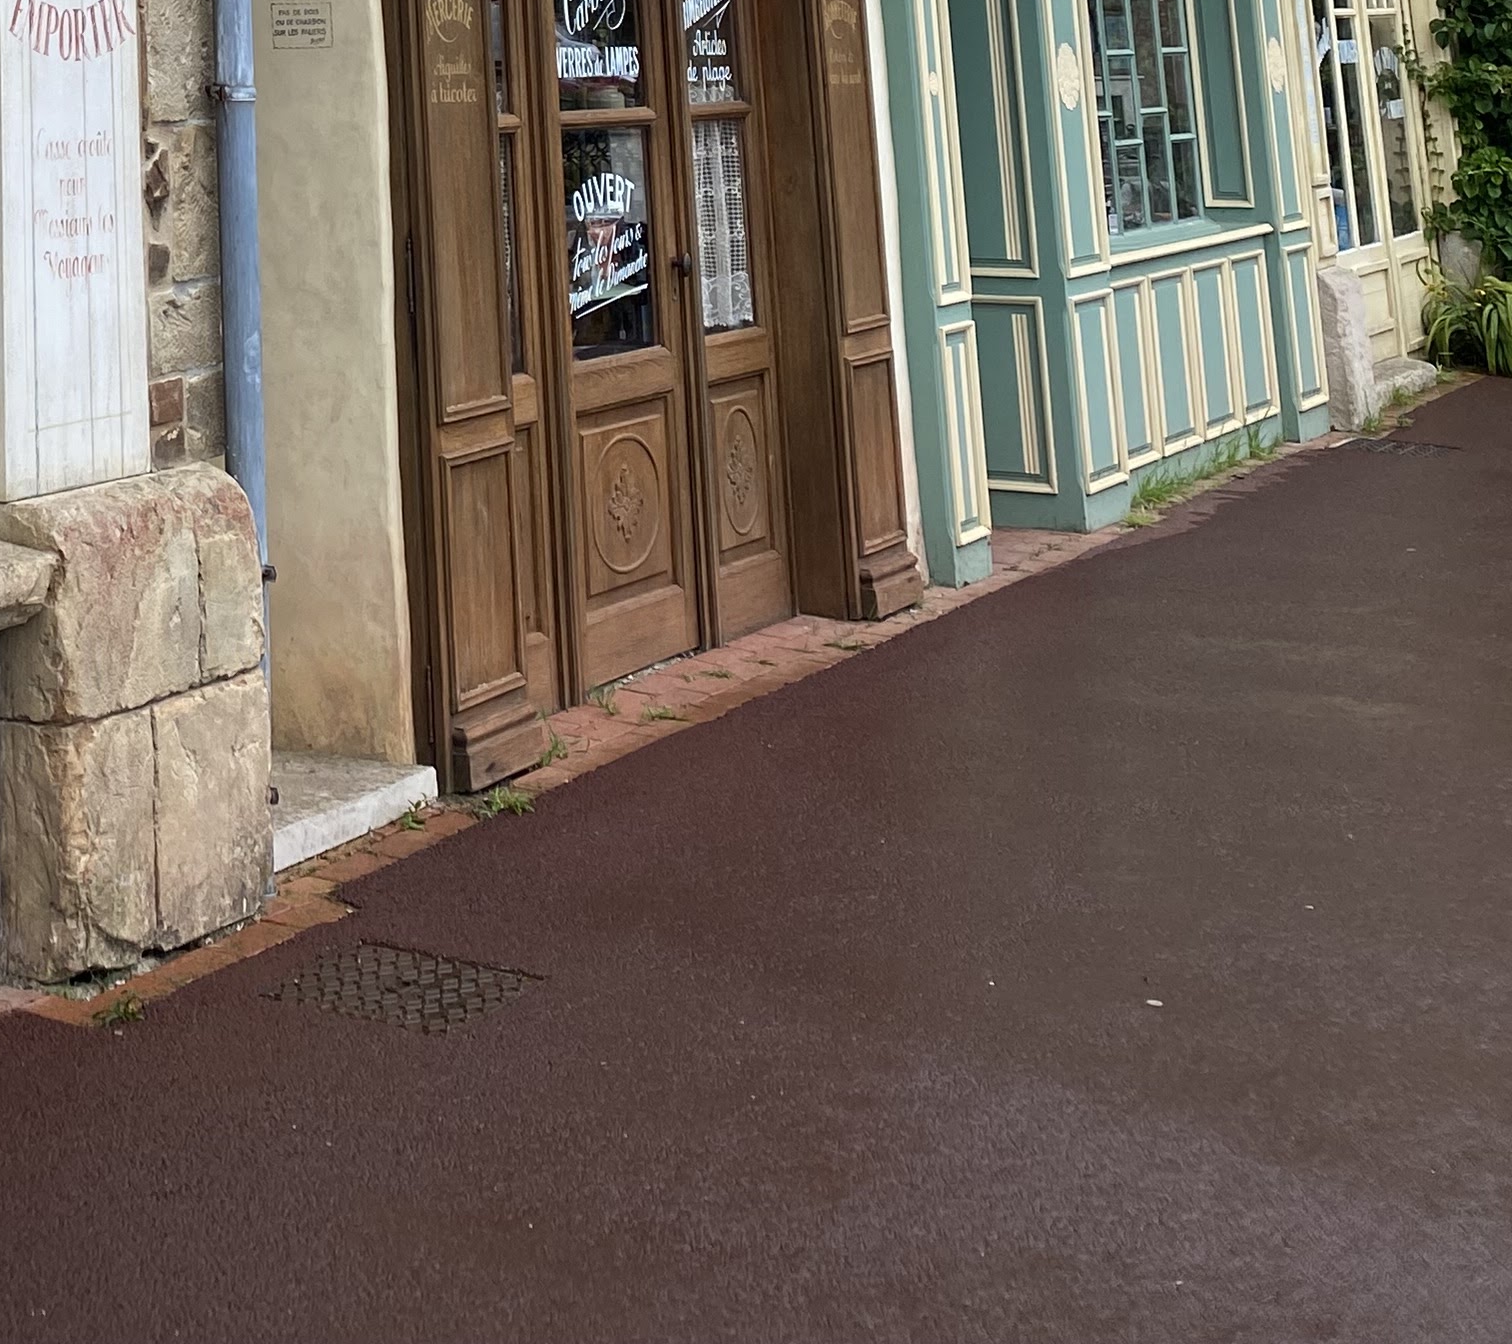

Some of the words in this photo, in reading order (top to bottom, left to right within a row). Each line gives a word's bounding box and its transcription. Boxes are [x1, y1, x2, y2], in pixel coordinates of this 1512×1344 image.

[555, 46, 593, 79] VERRES
[604, 45, 640, 78] LAMPES
[687, 59, 699, 82] de
[702, 58, 733, 92] plage
[572, 172, 636, 223] OUVERT
